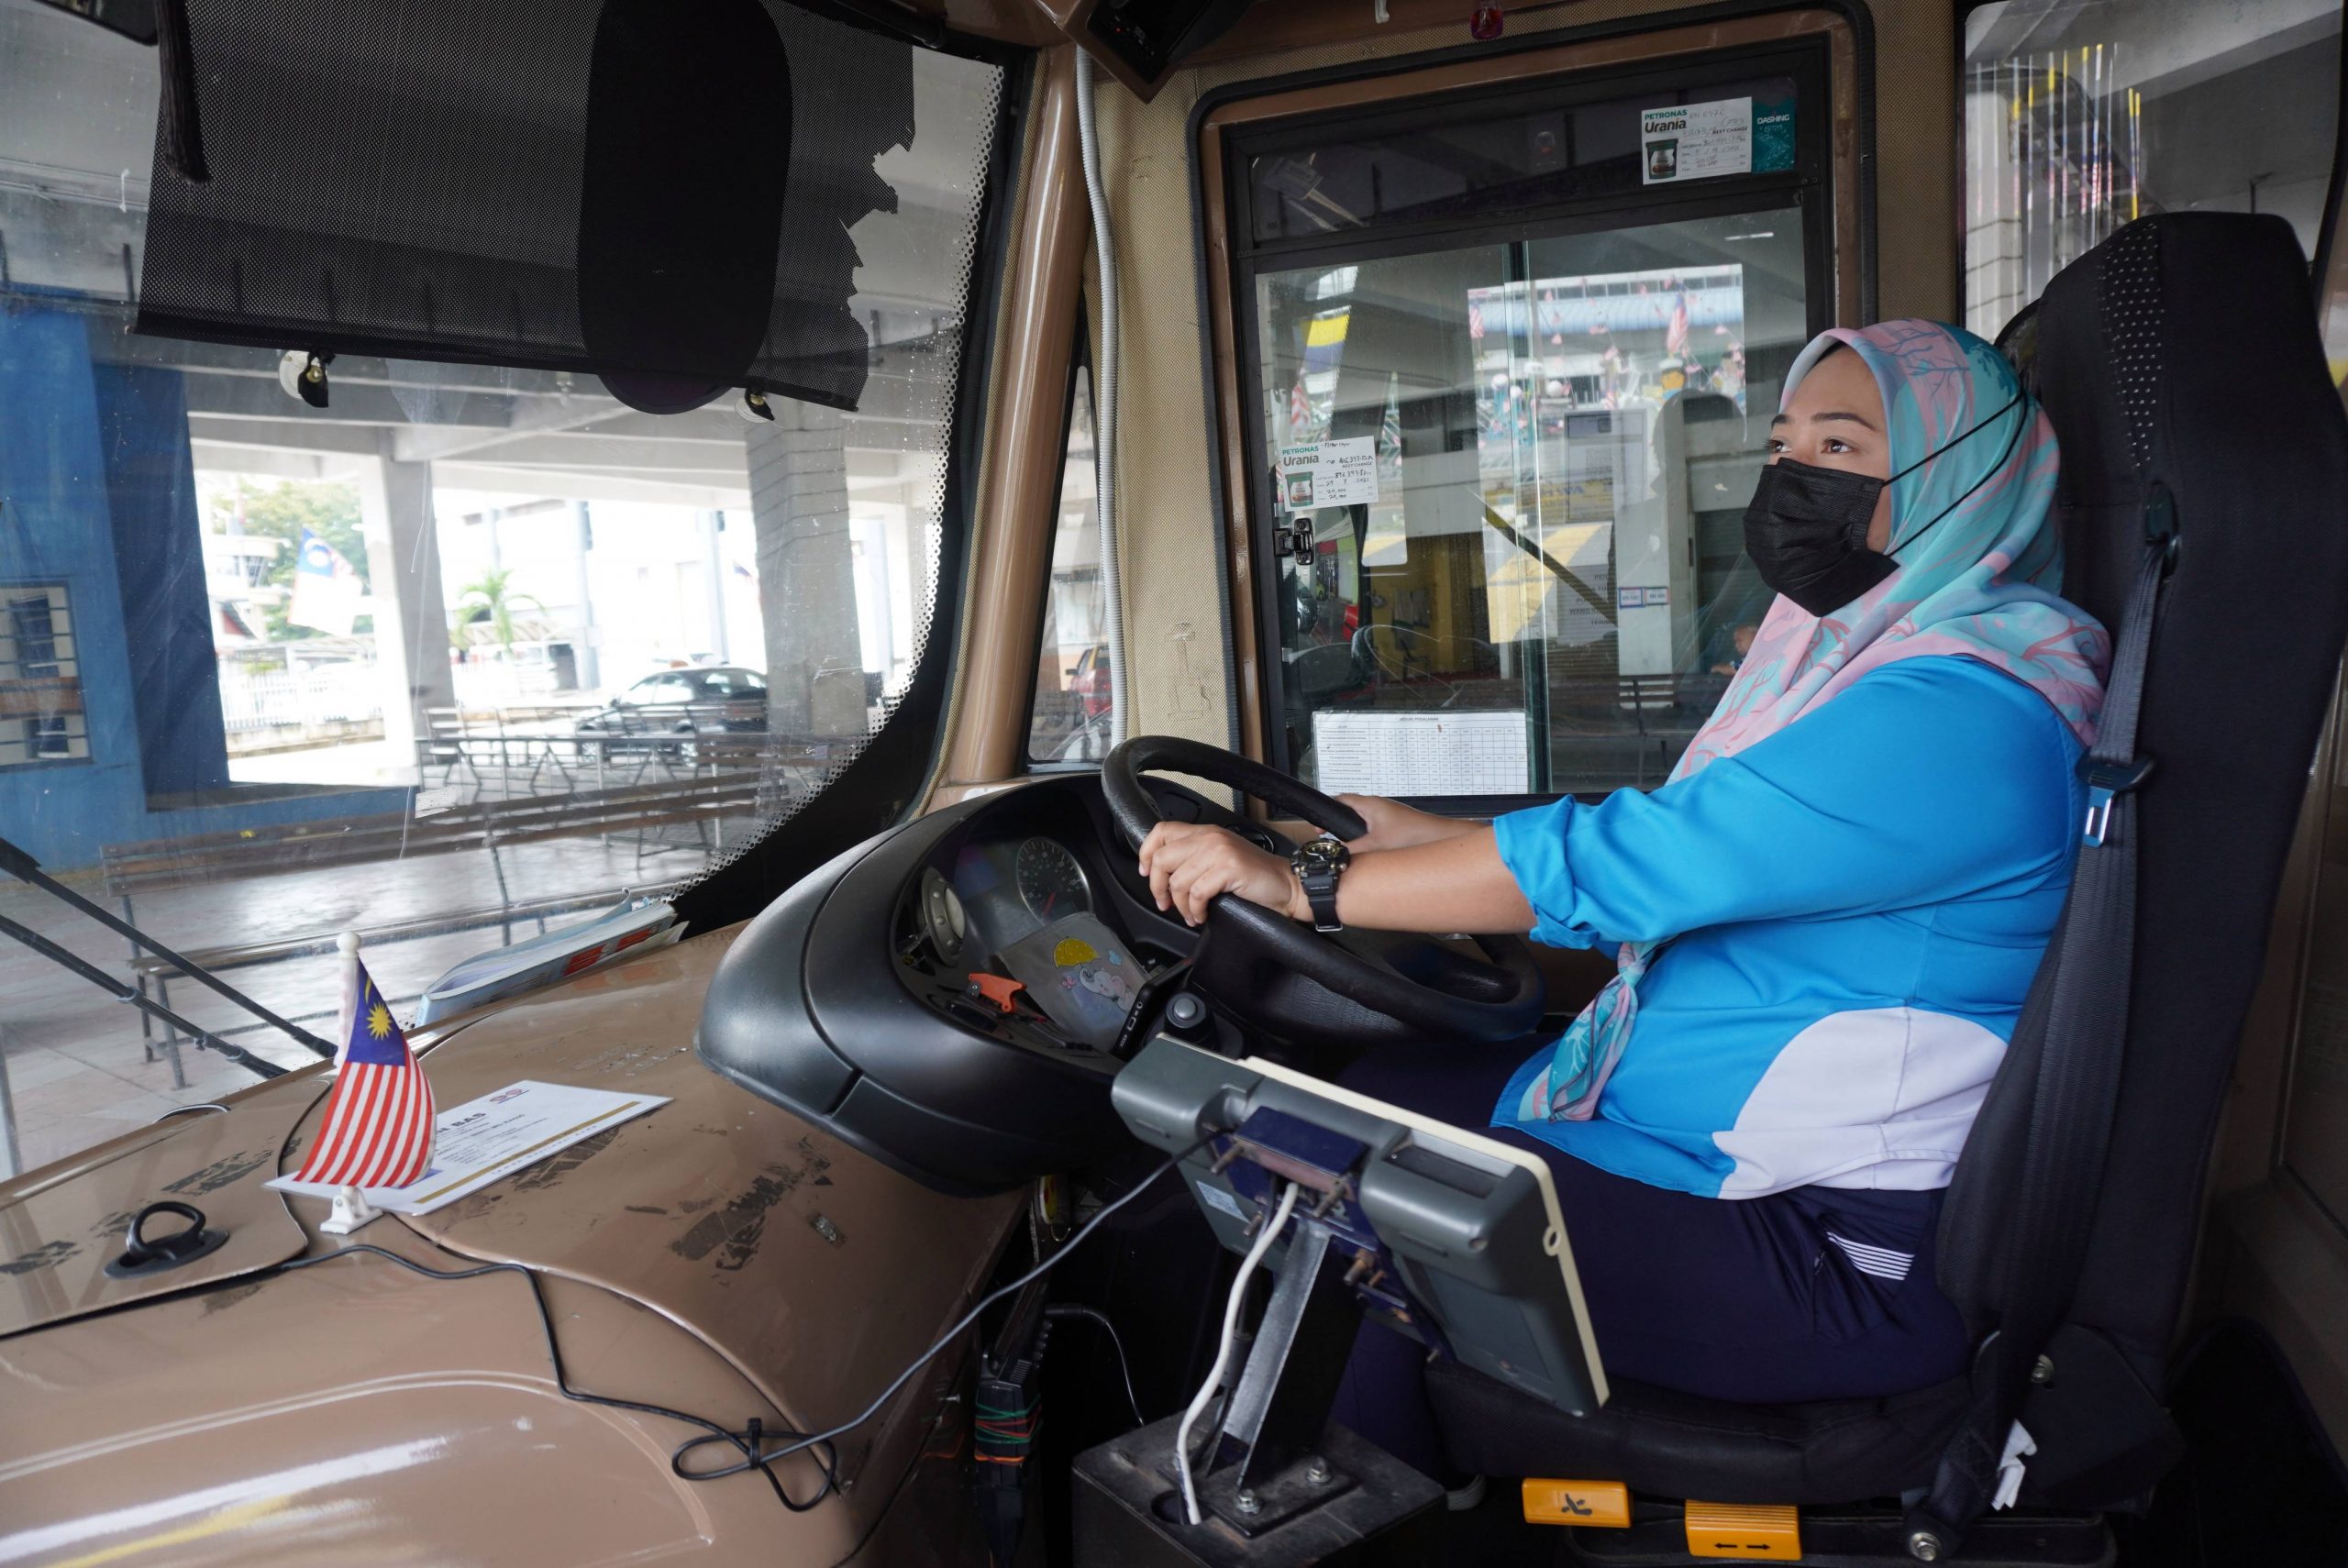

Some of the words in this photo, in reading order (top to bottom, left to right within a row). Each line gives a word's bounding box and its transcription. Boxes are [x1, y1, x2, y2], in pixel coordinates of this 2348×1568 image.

[1645, 109, 1688, 120] PETRONAS
[1756, 114, 1790, 125] DASHING
[1645, 118, 1687, 133] Urania
[1282, 446, 1319, 455] PETRONAS
[1283, 455, 1319, 467] Urania
[450, 1112, 487, 1127] BAS
